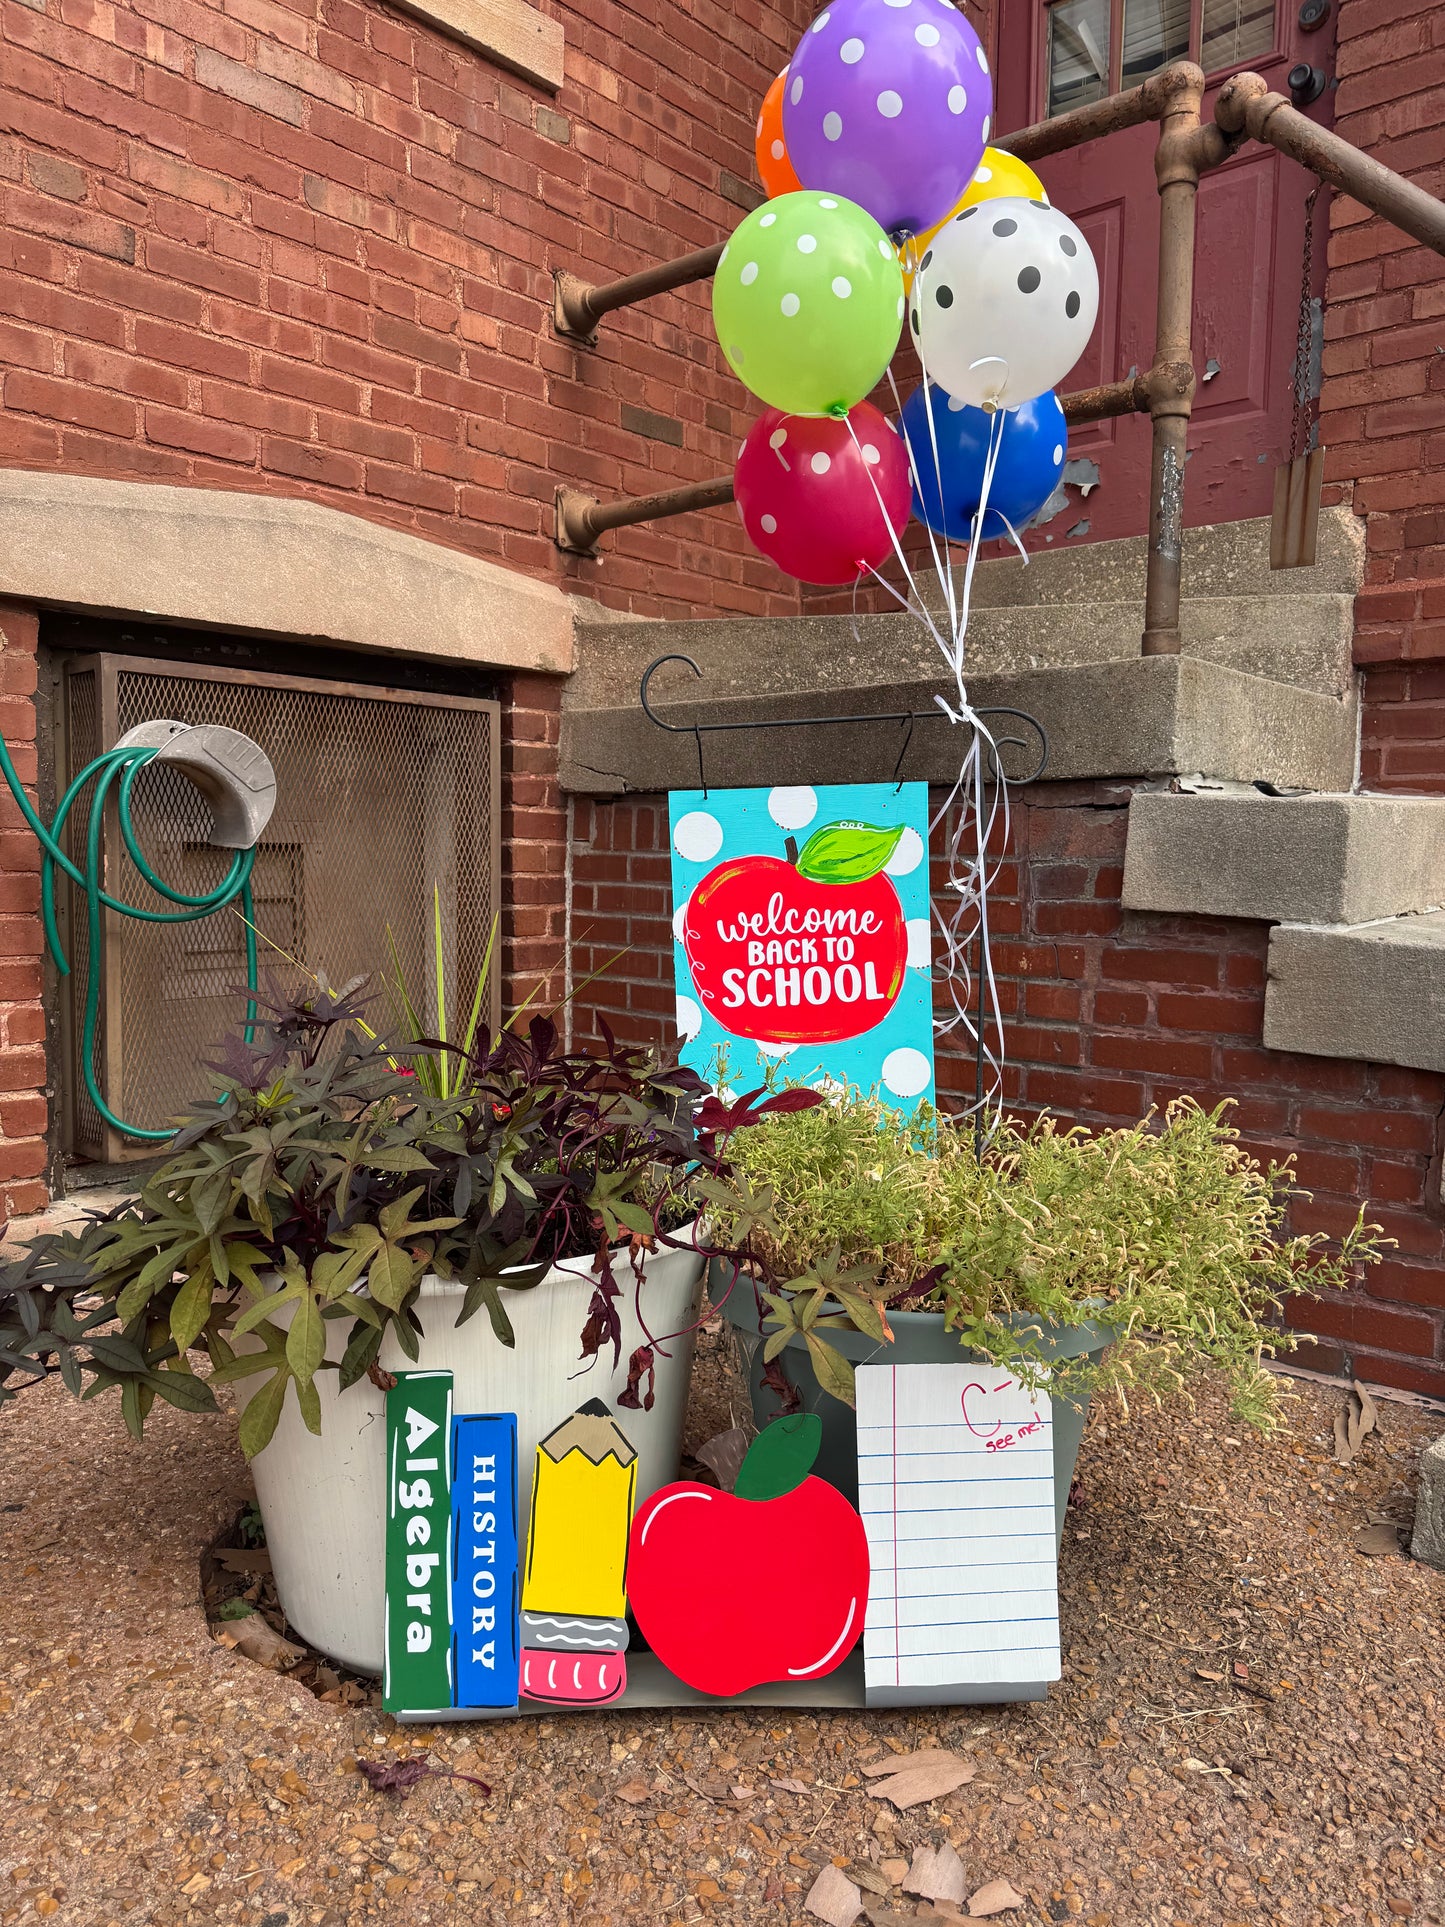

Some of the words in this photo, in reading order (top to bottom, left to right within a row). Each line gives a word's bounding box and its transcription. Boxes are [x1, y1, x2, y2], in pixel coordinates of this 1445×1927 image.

[717, 892, 883, 942] welcome
[748, 937, 818, 966] BACK
[822, 936, 855, 963] TO
[722, 961, 885, 1008] SCHOOL
[986, 1434, 1016, 1453] see
[1018, 1411, 1045, 1439] me!
[399, 1406, 440, 1653] Algebra
[472, 1454, 496, 1670] HISTORY
